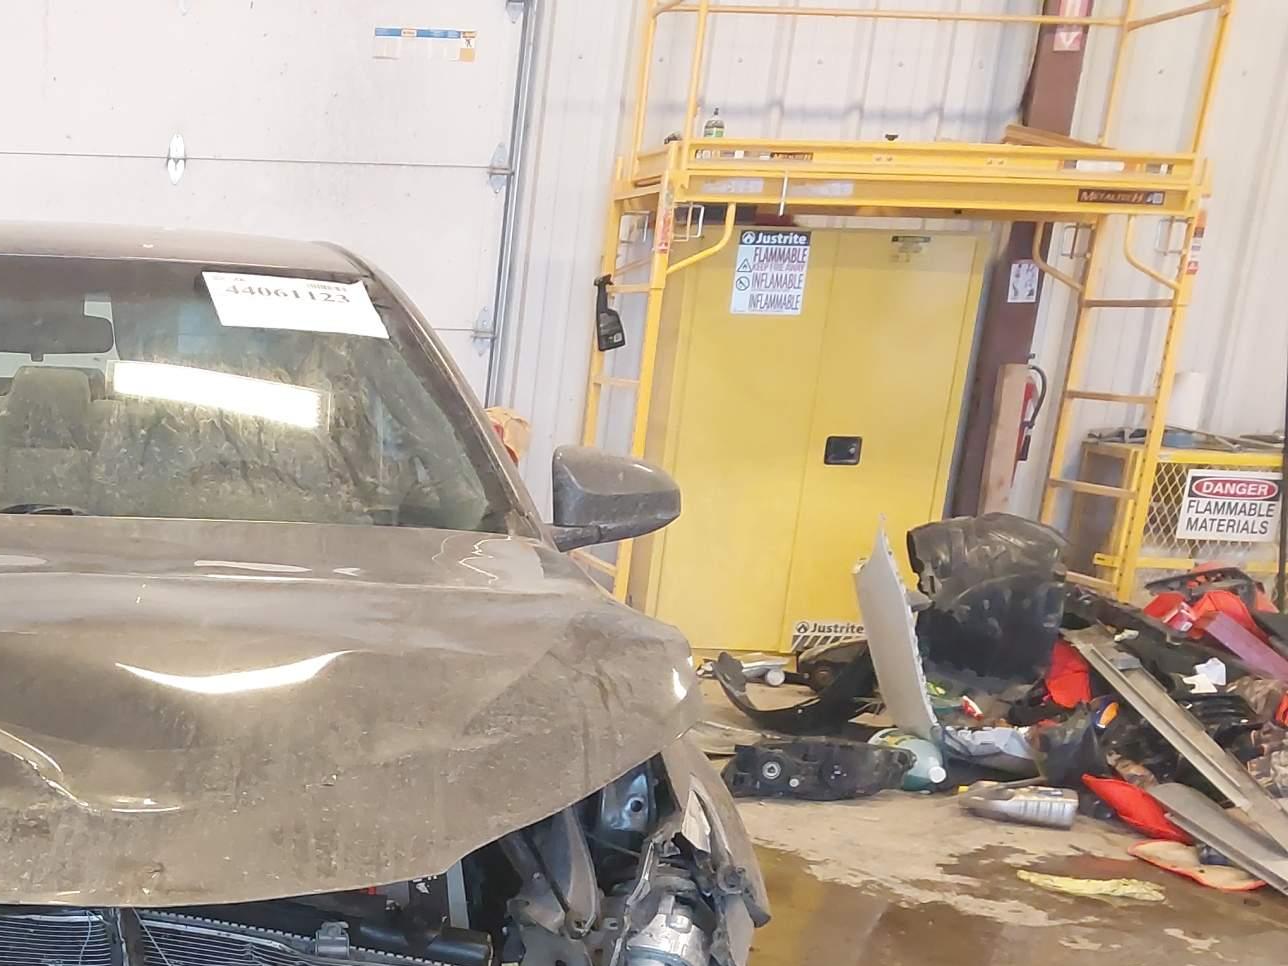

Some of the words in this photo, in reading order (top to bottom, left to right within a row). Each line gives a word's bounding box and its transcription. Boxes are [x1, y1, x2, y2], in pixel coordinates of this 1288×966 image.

[756, 232, 808, 245] Justrite
[753, 247, 808, 263] FLAMMABLE
[751, 273, 804, 289] INFLAMABLE
[225, 284, 350, 304] 44061123
[748, 293, 801, 310] INFLAMMABLE
[1201, 481, 1270, 497] DANGER
[1186, 500, 1276, 518] FLAMMABLE
[1185, 517, 1269, 535] MATERIALS
[810, 622, 865, 634] Justrite
